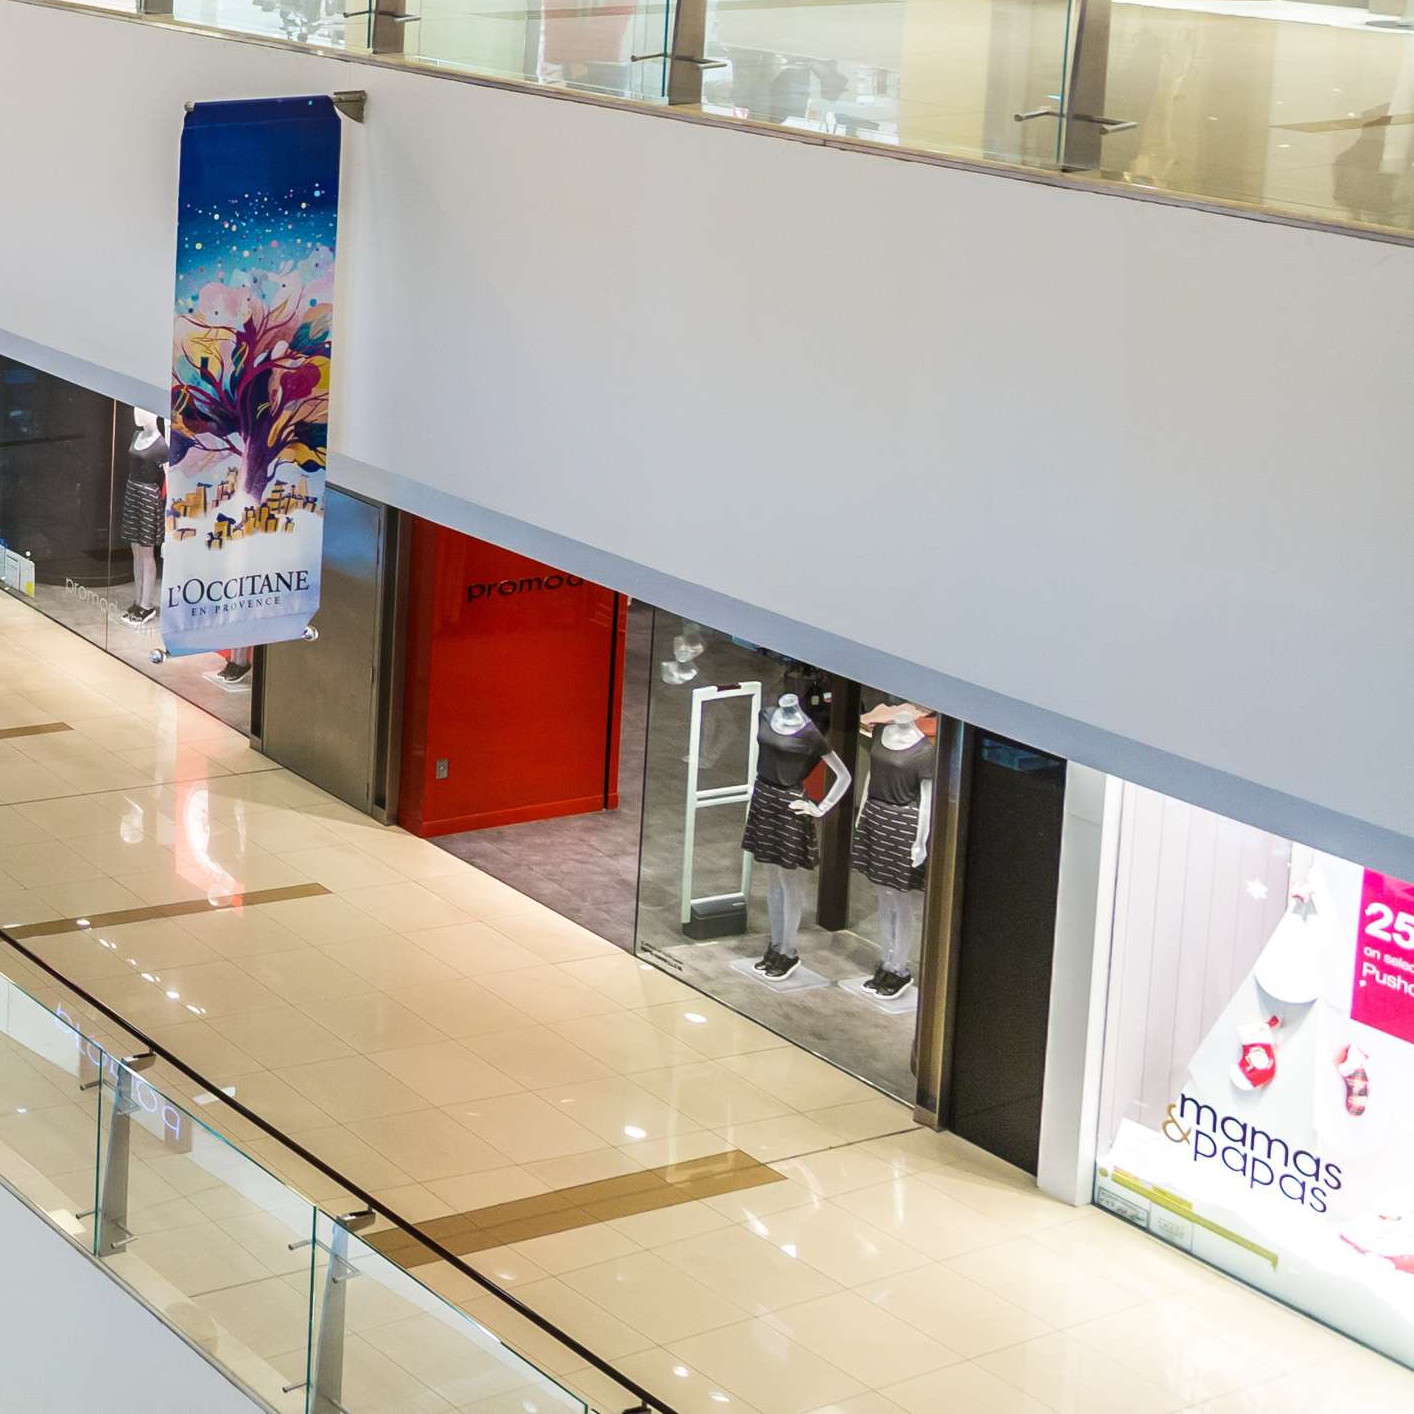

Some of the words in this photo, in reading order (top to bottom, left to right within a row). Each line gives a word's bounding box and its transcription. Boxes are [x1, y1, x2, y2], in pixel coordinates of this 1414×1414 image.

[168, 570, 310, 610] L'OCCITANE
[192, 608, 206, 616] EN
[214, 594, 280, 615] PROVENCE
[1363, 947, 1380, 960] on
[1178, 1092, 1342, 1191] mamas
[1194, 1130, 1328, 1214] papas
